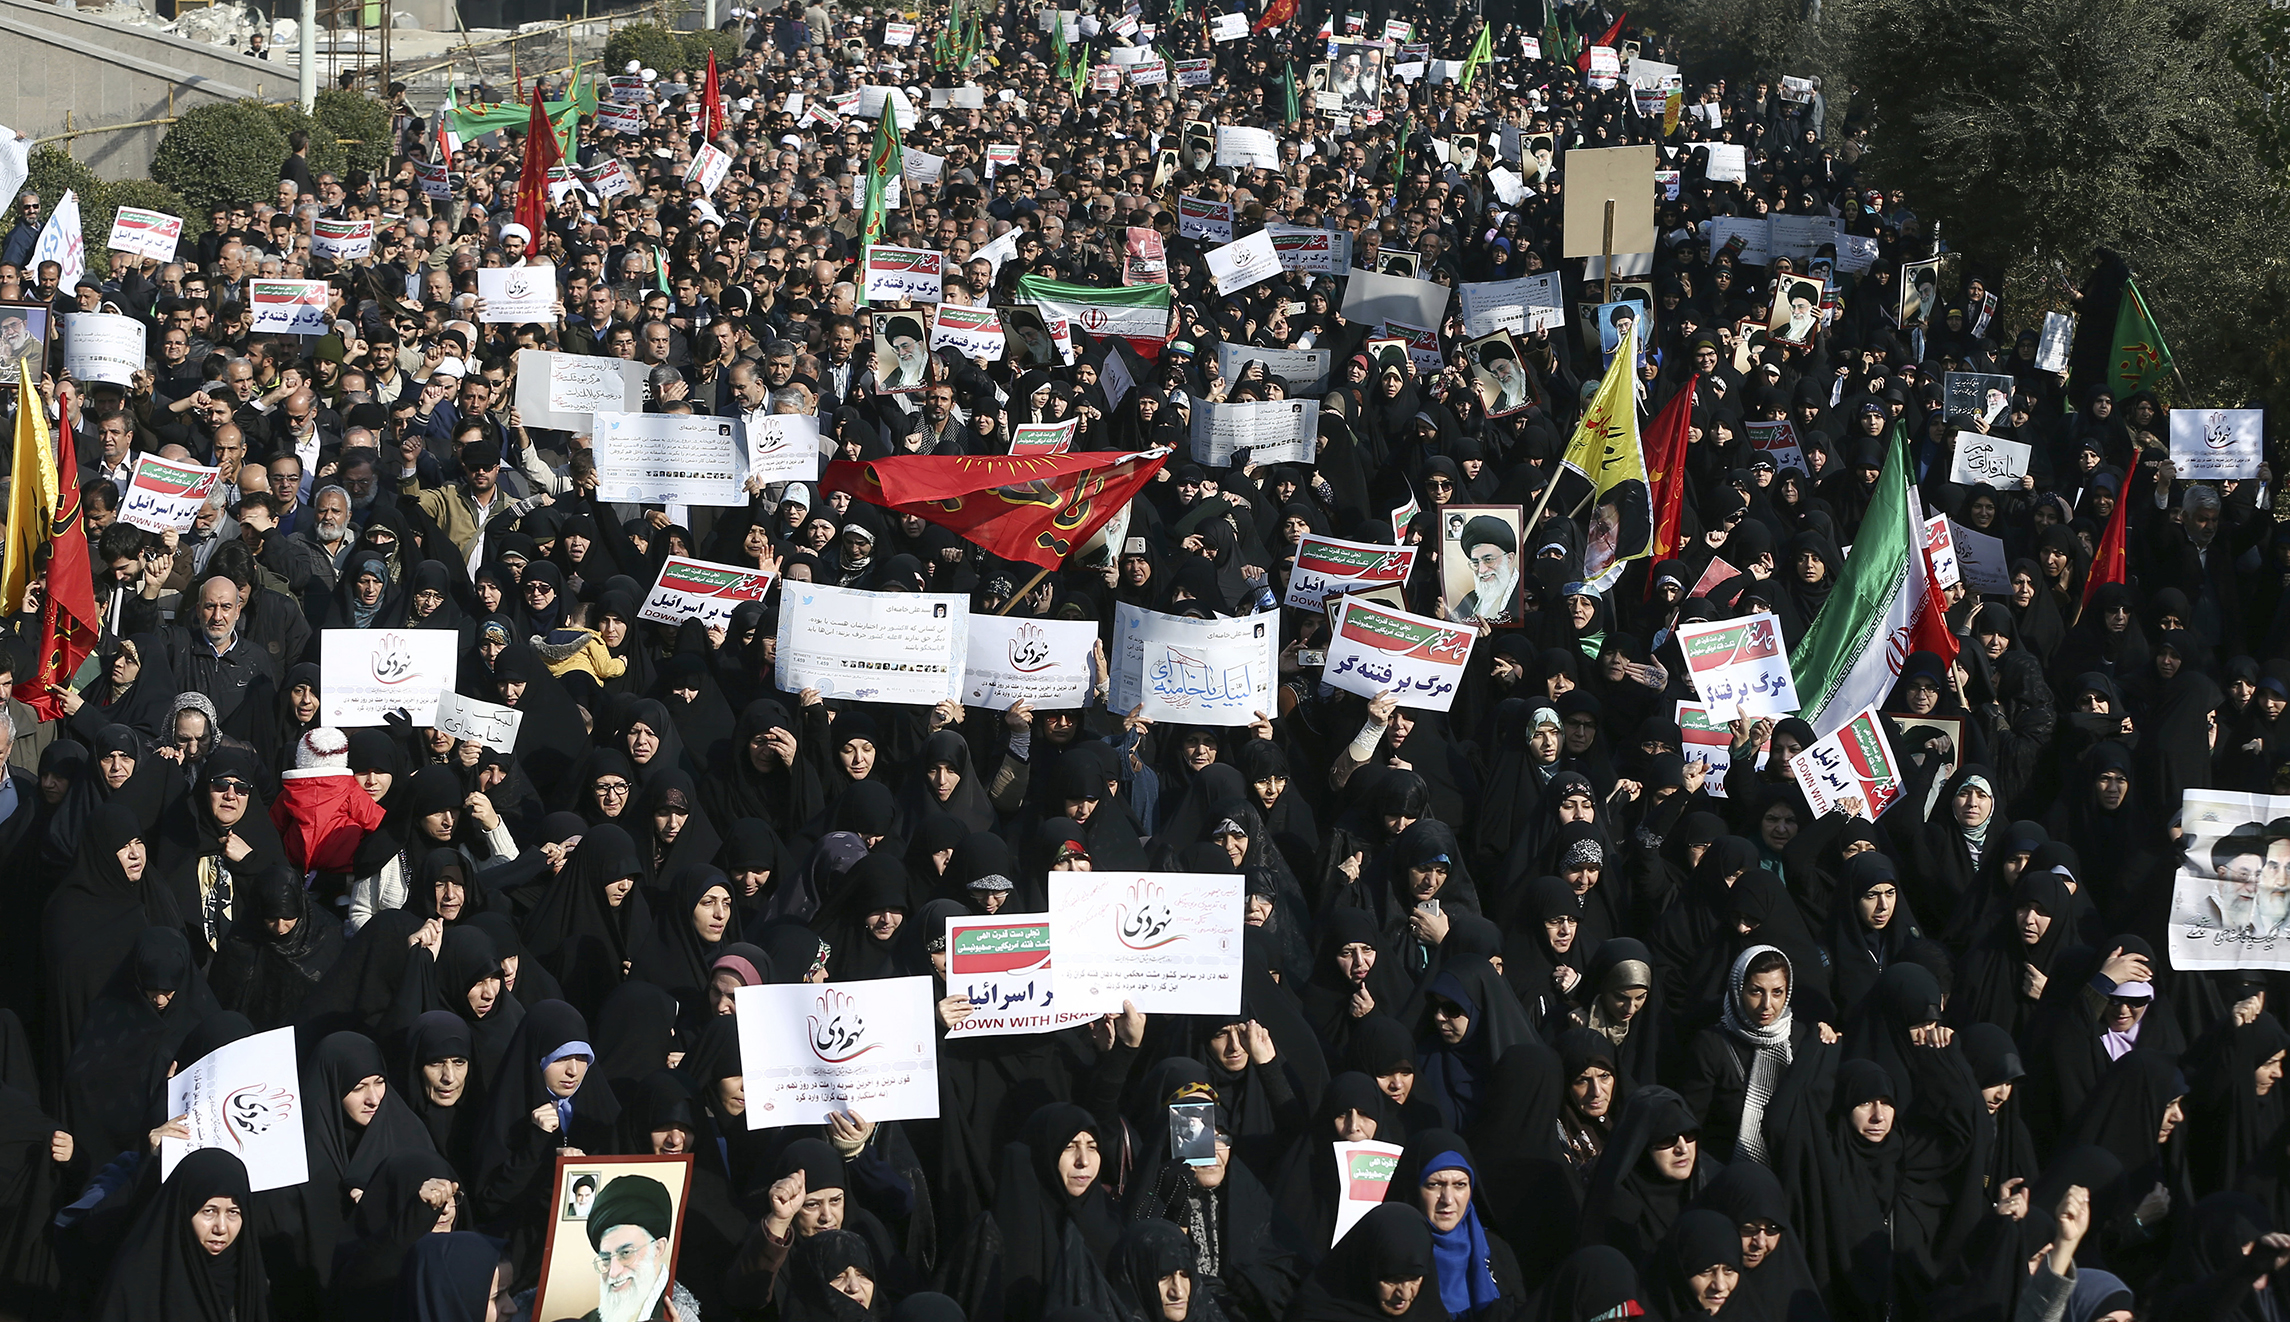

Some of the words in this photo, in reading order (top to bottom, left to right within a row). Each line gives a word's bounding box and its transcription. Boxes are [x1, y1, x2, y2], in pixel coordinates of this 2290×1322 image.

[608, 179, 625, 188] مرگ
[433, 185, 448, 193] مرگ
[114, 230, 144, 242] اسرائیل
[1214, 226, 1230, 237] مرگ
[155, 240, 173, 251] مرگ
[148, 250, 170, 260] ISRAEL
[1310, 254, 1329, 262] مرگ
[905, 282, 914, 293] بر
[917, 281, 939, 295] مرگ
[290, 314, 300, 326] بر
[968, 342, 979, 352] بر
[982, 340, 1001, 354] مرگ
[1422, 355, 1441, 365] مرگ
[562, 372, 578, 381] شکست
[586, 373, 601, 384] هرگز
[1780, 452, 1801, 465] مرگ
[128, 495, 174, 516] اسرائیل
[173, 508, 183, 520] بر
[122, 514, 151, 526] DOWN
[651, 594, 705, 613] اسرائیل
[1290, 594, 1324, 609] DOWN
[644, 609, 678, 622] DOWN
[703, 607, 719, 620] بر
[1364, 614, 1374, 622] الهی
[850, 621, 878, 630] اختیارشان
[1375, 616, 1388, 625] قدرت
[1388, 620, 1400, 628] دست
[807, 627, 817, 635] باید
[919, 625, 936, 633] کسانی
[937, 625, 946, 633] این
[1400, 624, 1412, 632] تجلی
[921, 635, 931, 643] حق
[933, 635, 945, 643] دیگر
[1405, 633, 1420, 642] شکست
[1014, 641, 1035, 663] دی
[1390, 675, 1411, 693] بر
[1415, 675, 1452, 696] مرگ
[1752, 671, 1786, 697] مرگ
[1738, 682, 1750, 704] بر
[454, 695, 464, 715] یا
[473, 710, 515, 727] لبیک
[1812, 747, 1850, 792] اسرائیل
[1796, 757, 1816, 788] DOWN
[1811, 787, 1828, 814] WITH
[976, 930, 990, 941] الهی
[992, 929, 1008, 939] قدرت
[1010, 930, 1024, 938] دست
[1025, 928, 1040, 938] تجلی
[1020, 940, 1034, 948] فتنه
[1124, 971, 1144, 979] محکمی
[1162, 971, 1177, 980] کشور
[1178, 972, 1196, 980] سراسر
[1198, 972, 1205, 980] در
[1218, 971, 1229, 980] نهم
[1138, 983, 1149, 991] خود
[1152, 983, 1157, 991] را
[1158, 983, 1167, 991] کار
[1167, 983, 1178, 992] این
[953, 1018, 1004, 1031] DOWN
[1010, 1015, 1050, 1028] WITH
[817, 1015, 845, 1050] دی
[786, 1080, 798, 1090] نهم
[800, 1080, 809, 1090] روز
[830, 1081, 835, 1089] را
[837, 1080, 854, 1088] ضربه
[856, 1078, 874, 1090] آخرین
[881, 1076, 896, 1087] ترین
[898, 1074, 910, 1086] قوی
[775, 1083, 784, 1091] دی
[811, 1082, 818, 1090] در
[795, 1092, 805, 1102] کرد
[807, 1094, 819, 1102] وارد
[836, 1093, 848, 1101] فتنه
[856, 1090, 876, 1101] استکبار
